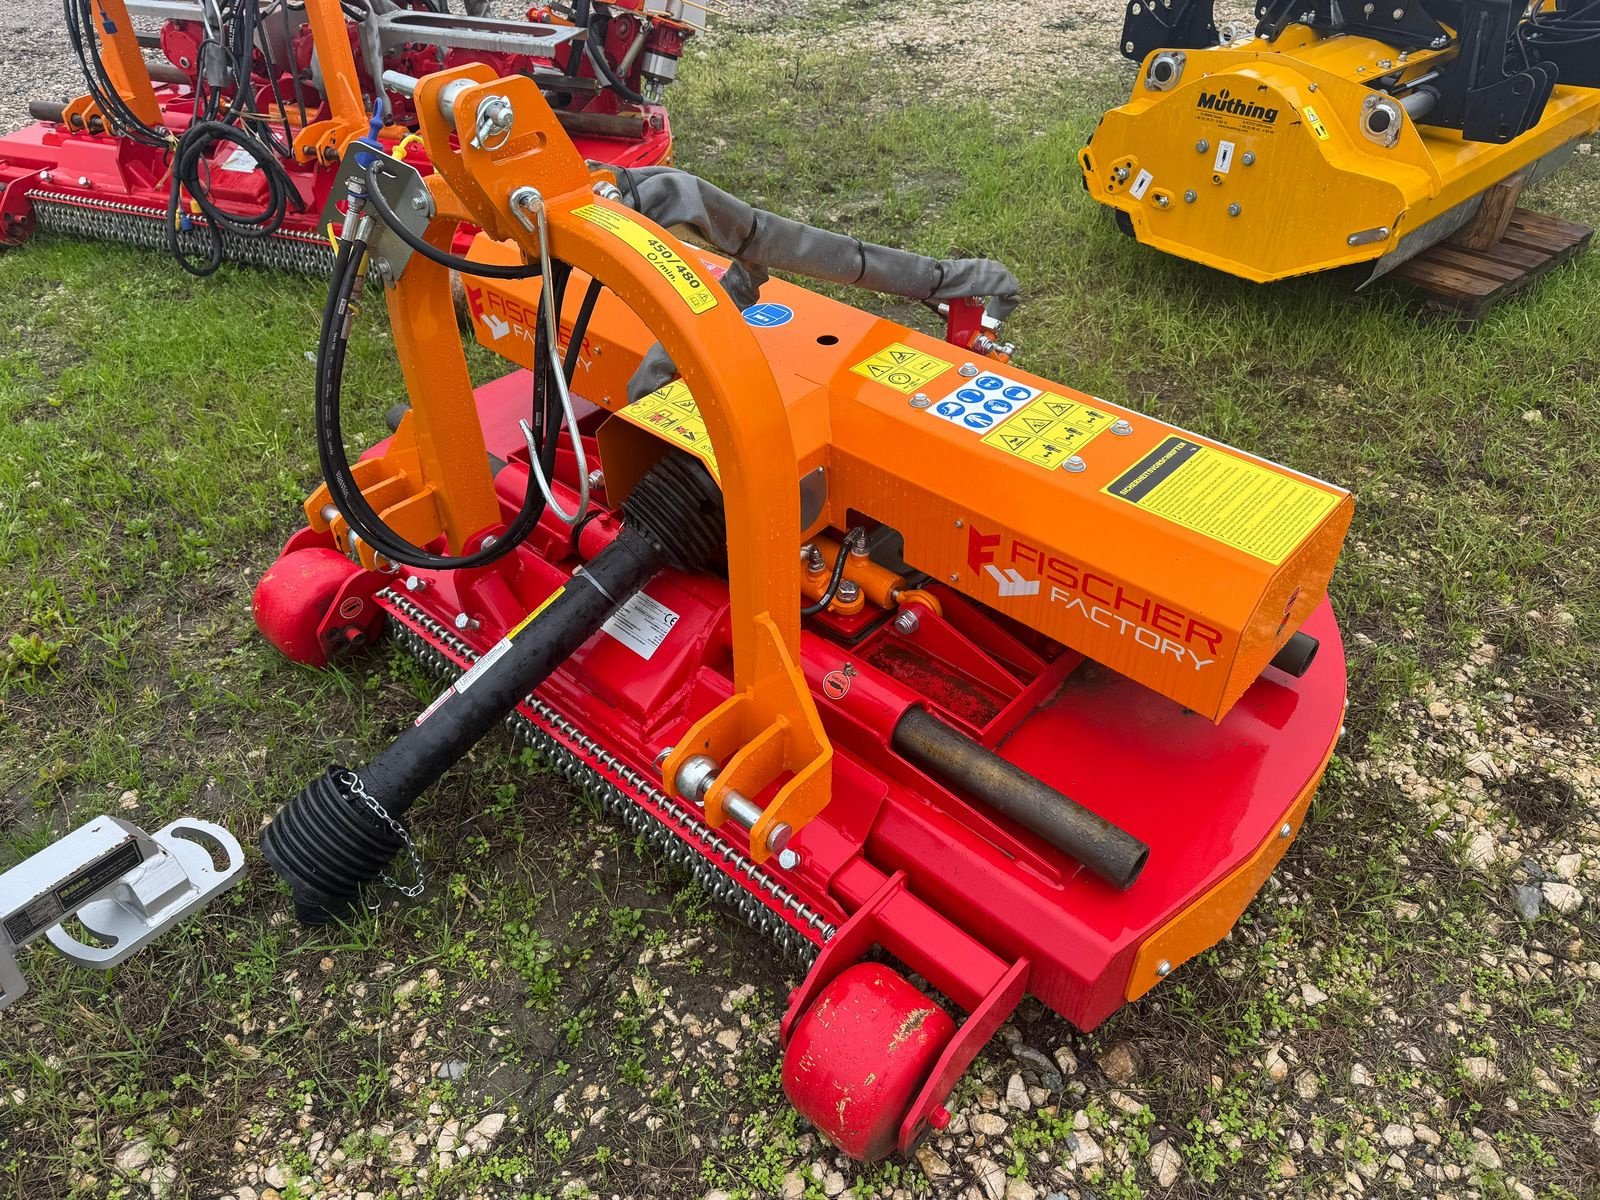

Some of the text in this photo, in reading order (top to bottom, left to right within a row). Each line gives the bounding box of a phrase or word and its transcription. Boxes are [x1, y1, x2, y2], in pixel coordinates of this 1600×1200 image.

[647, 239, 701, 289] 450/480
[487, 290, 592, 358] FISCER
[1010, 539, 1223, 656] FISCHER
[1050, 586, 1215, 671] FACTORY
